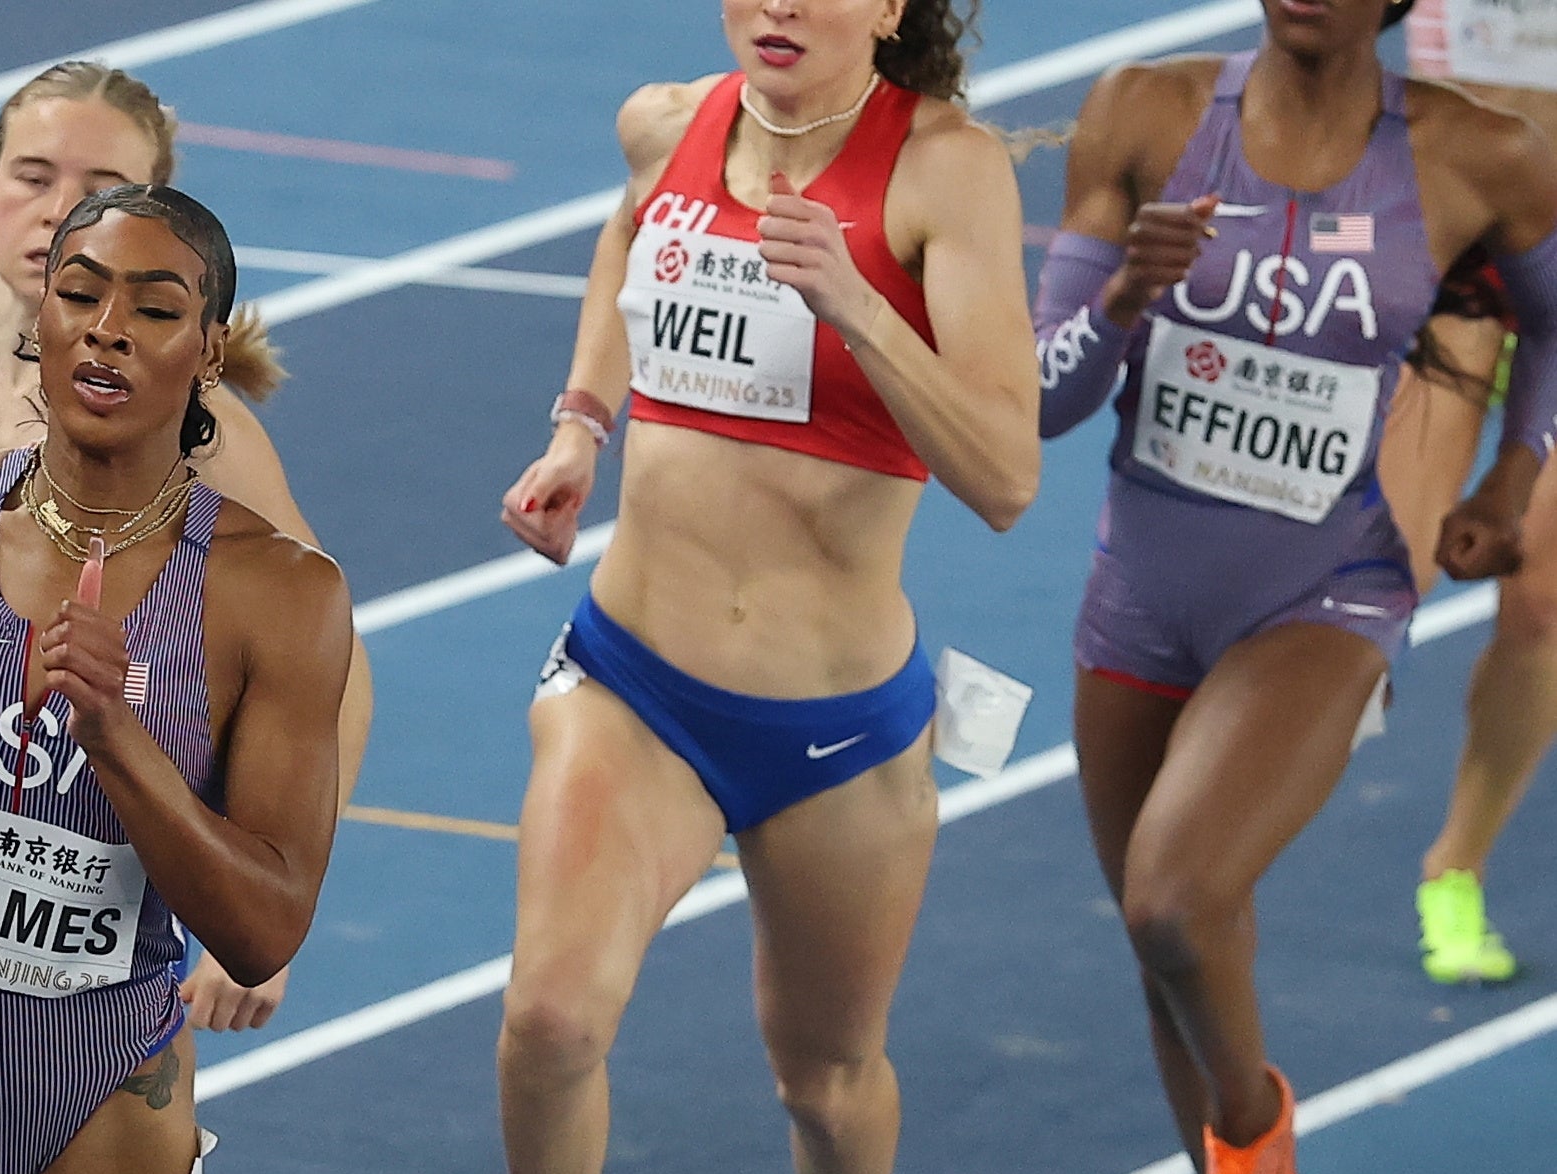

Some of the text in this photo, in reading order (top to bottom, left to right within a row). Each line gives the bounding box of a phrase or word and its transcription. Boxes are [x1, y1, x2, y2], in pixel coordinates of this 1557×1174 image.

[695, 248, 783, 290] 南京银
[1173, 249, 1378, 341] USA
[653, 299, 755, 366] WEIL
[658, 364, 760, 404] NANJING
[1153, 382, 1349, 476] EFFIONG
[29, 868, 45, 880] OF
[49, 875, 104, 895] NANJING
